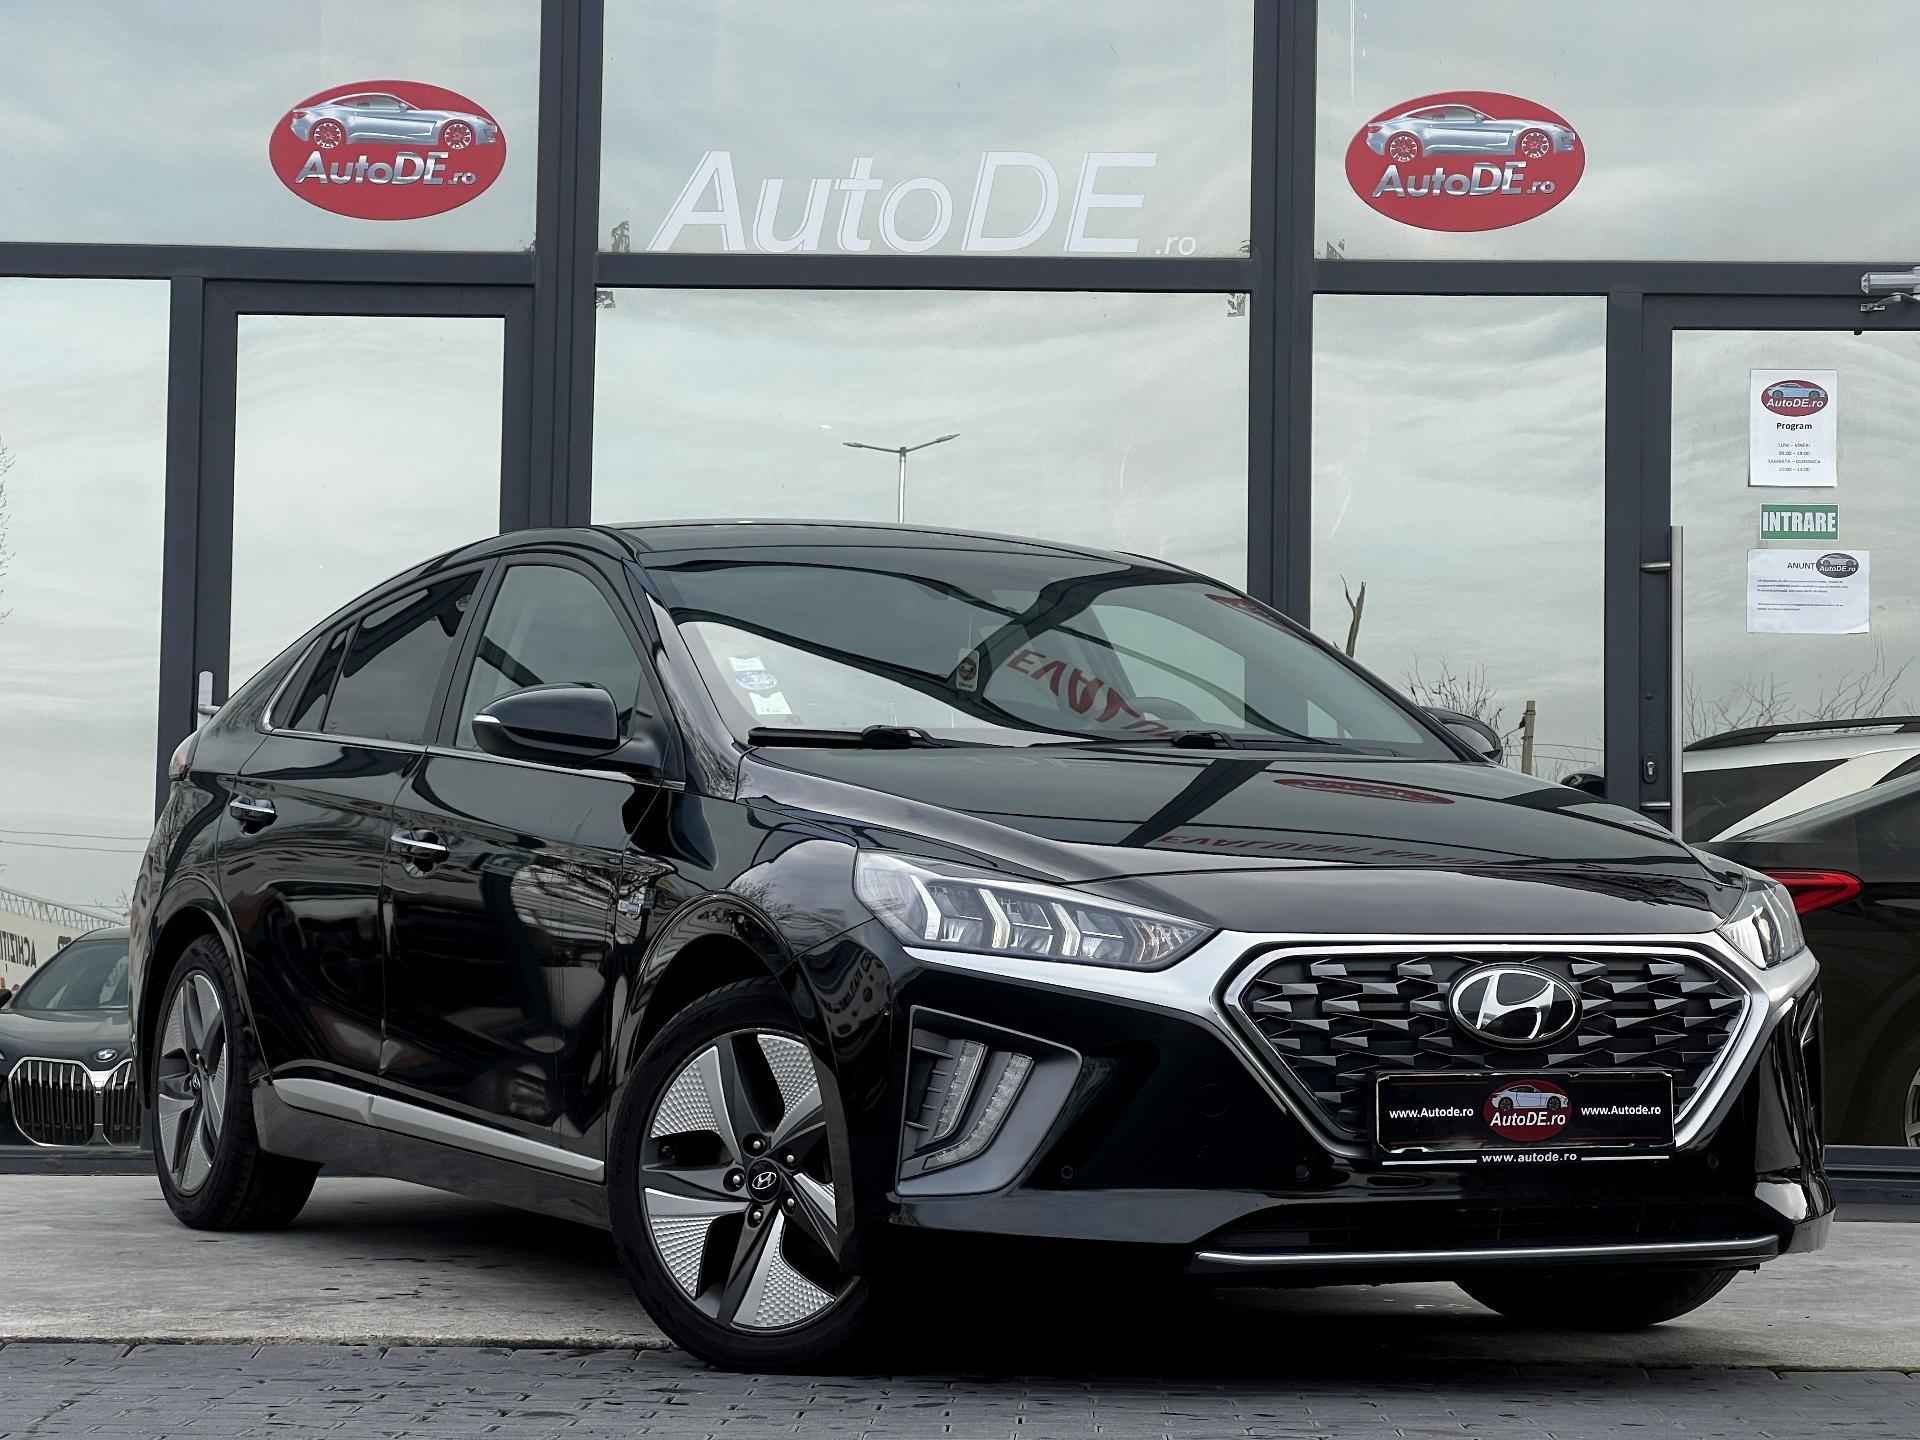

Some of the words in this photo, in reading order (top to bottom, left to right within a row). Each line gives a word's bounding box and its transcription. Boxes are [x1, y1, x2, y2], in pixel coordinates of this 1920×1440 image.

[1766, 398, 1824, 408] AutoDE.ro
[1776, 422, 1813, 432] Program
[1762, 511, 1837, 532] INTRARE
[1819, 565, 1856, 573] AutoDE.ro
[1389, 1105, 1475, 1119] www.Autode.ro
[1581, 1104, 1662, 1116] www.Autode.ro
[1490, 1111, 1567, 1128] AutoDE.ro
[1481, 1151, 1578, 1163] www.autode.ro
